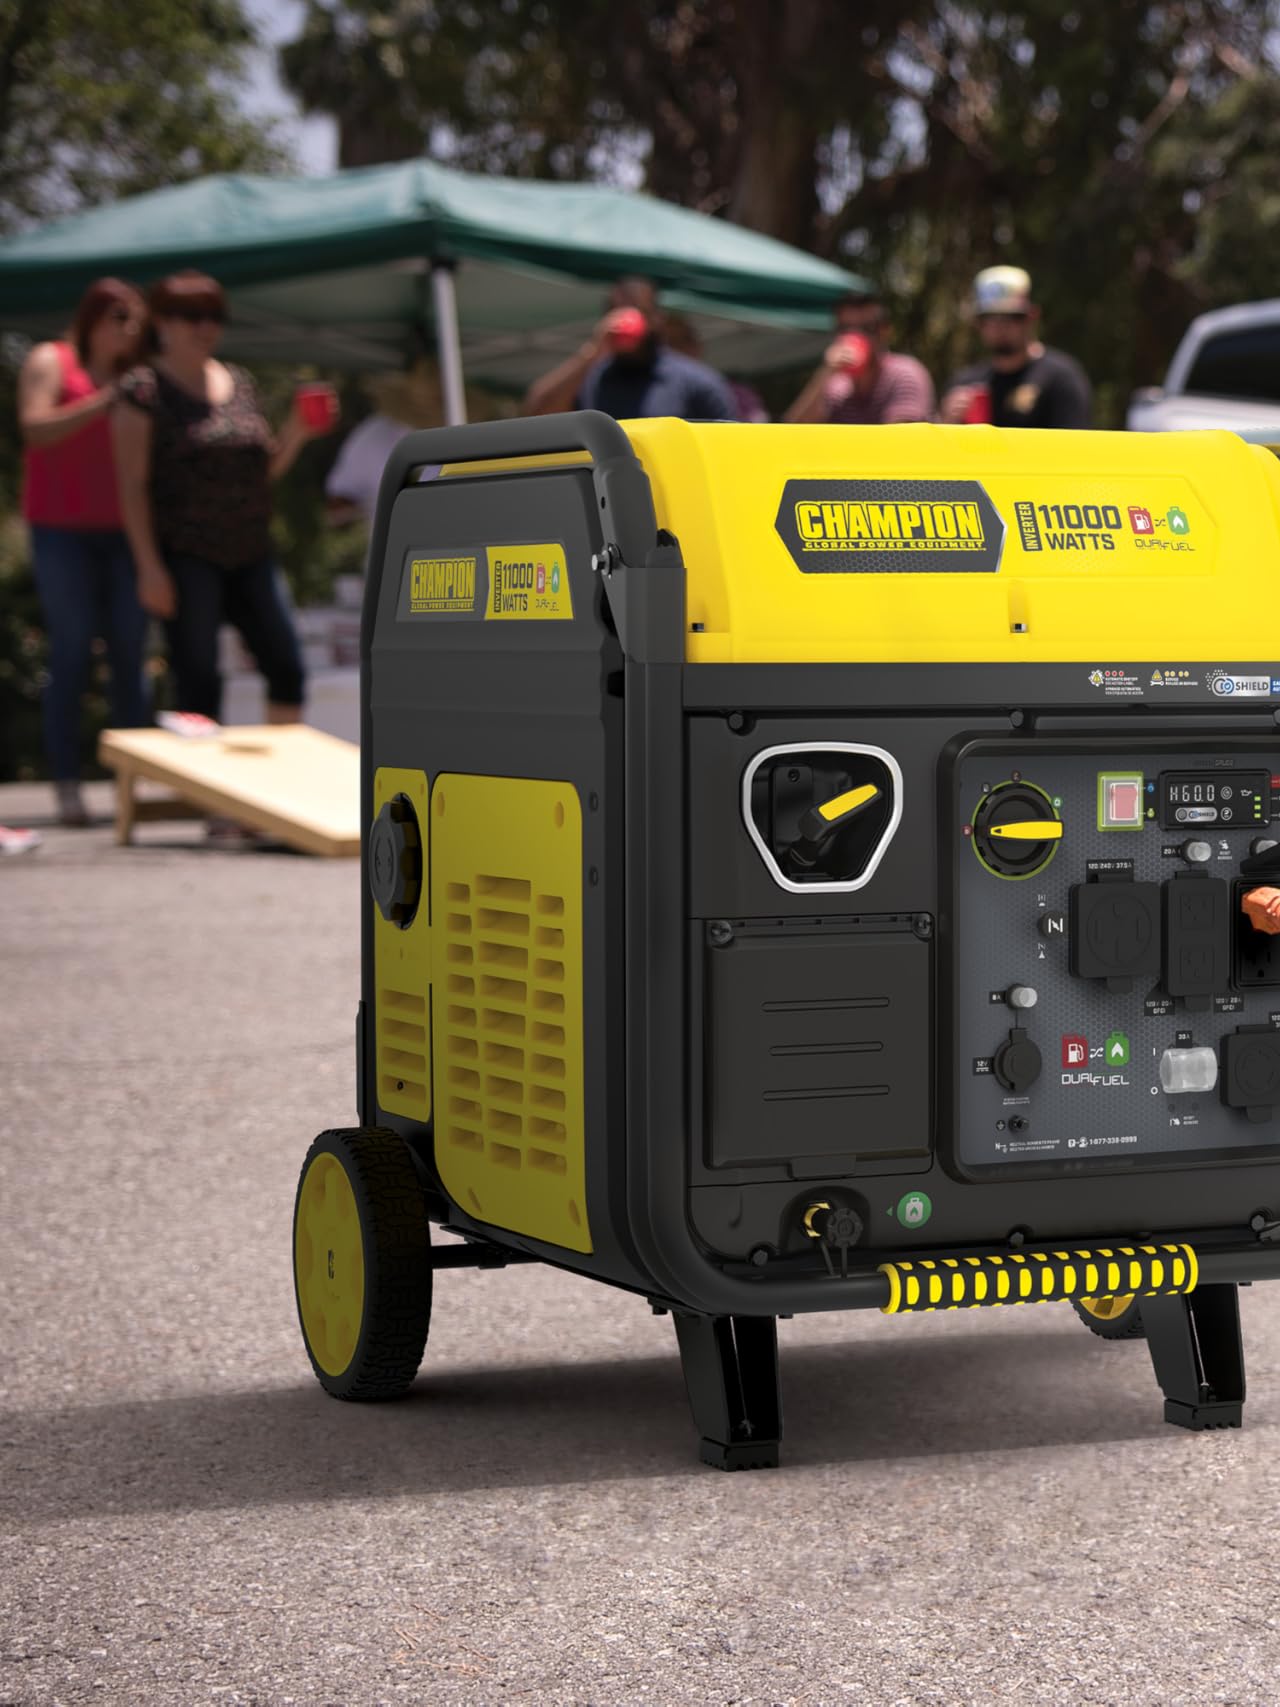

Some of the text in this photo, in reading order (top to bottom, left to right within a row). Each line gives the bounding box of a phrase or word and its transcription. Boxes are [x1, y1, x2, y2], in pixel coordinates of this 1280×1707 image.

[796, 502, 984, 540] CHAMPION
[1017, 503, 1040, 550] INVERTER
[1038, 504, 1122, 530] 11000
[805, 541, 984, 549] GLOBAL POWER EQUIPMENT
[1045, 533, 1115, 551] WATTS
[412, 558, 475, 600] CHAMPION
[494, 561, 502, 613] INVERTER
[502, 562, 534, 589] 11000
[502, 594, 528, 612] WATTS
[1236, 681, 1269, 691] SHIELD
